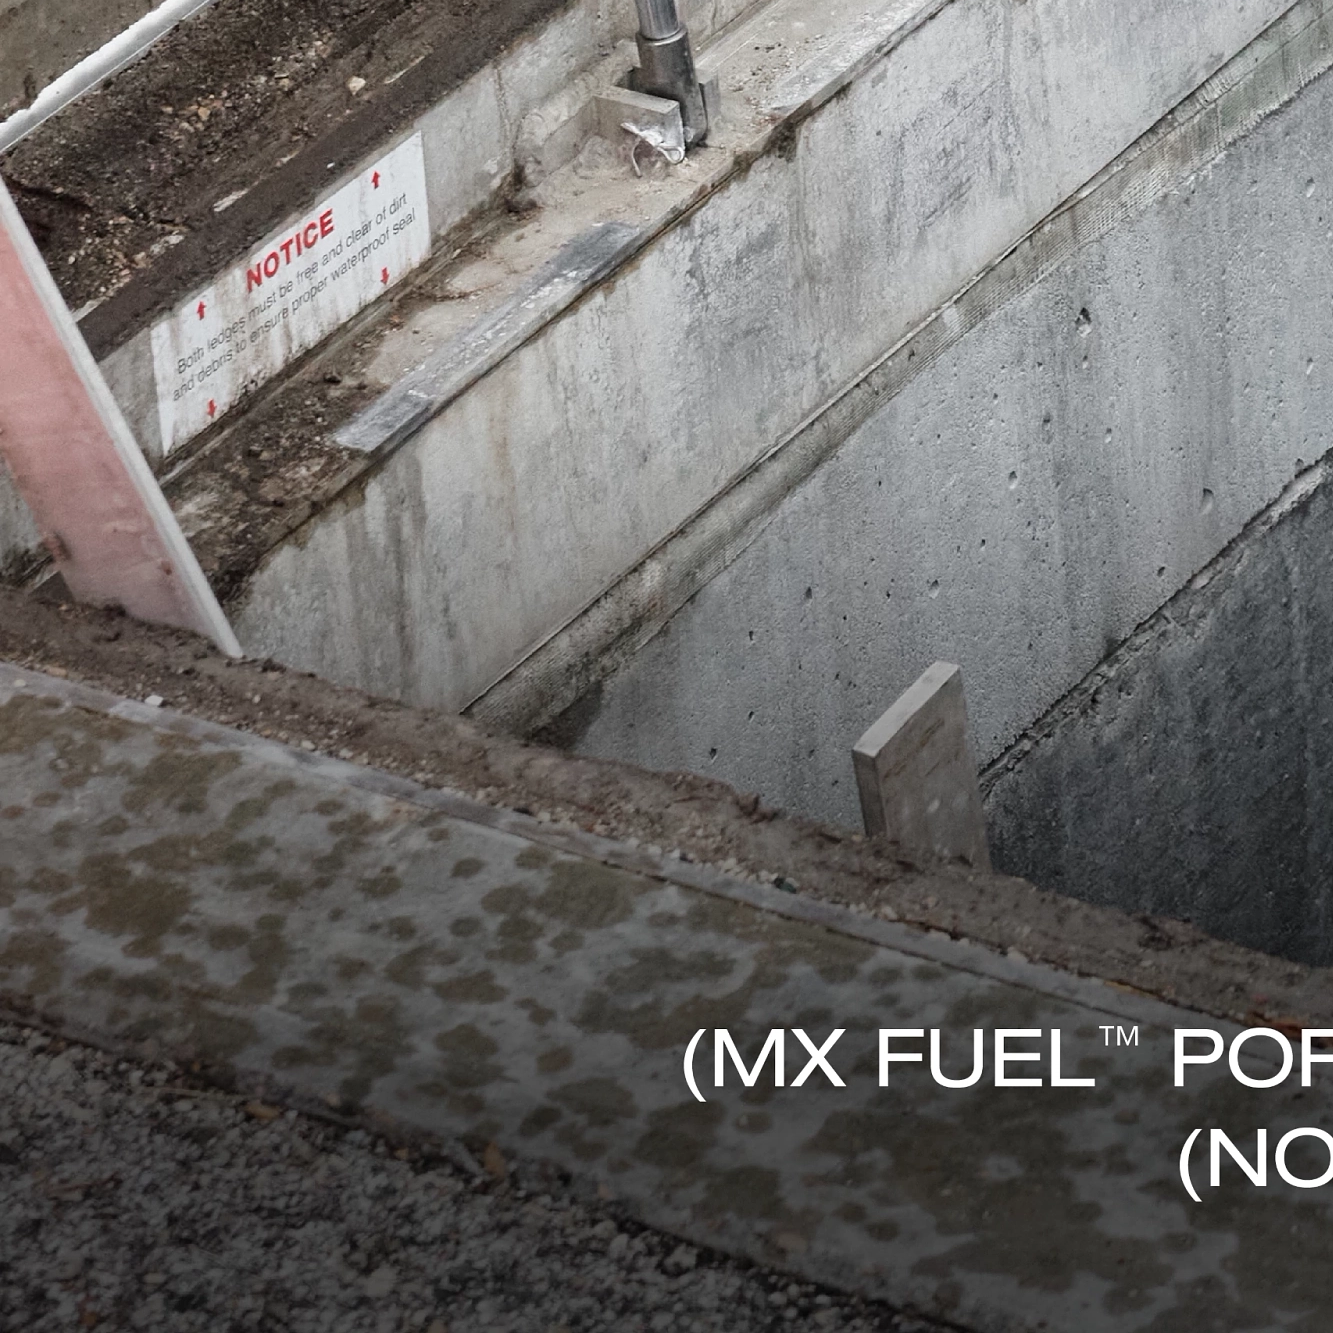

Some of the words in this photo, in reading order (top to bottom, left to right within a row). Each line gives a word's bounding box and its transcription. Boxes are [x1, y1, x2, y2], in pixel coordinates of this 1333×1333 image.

[173, 374, 195, 402] and
[197, 349, 233, 383] debris
[235, 339, 247, 354] to
[250, 307, 289, 343] ensure
[291, 275, 328, 315] proper
[331, 226, 389, 281] waterproof
[392, 207, 416, 235] seal
[177, 346, 204, 374] Both
[207, 316, 246, 352] ledges
[248, 291, 276, 321] must
[279, 280, 293, 298] be
[296, 262, 319, 284] free
[322, 239, 343, 266] and
[345, 219, 373, 248] clear
[375, 206, 387, 225] of
[389, 193, 407, 215] dirt
[246, 208, 334, 294] NOTICE
